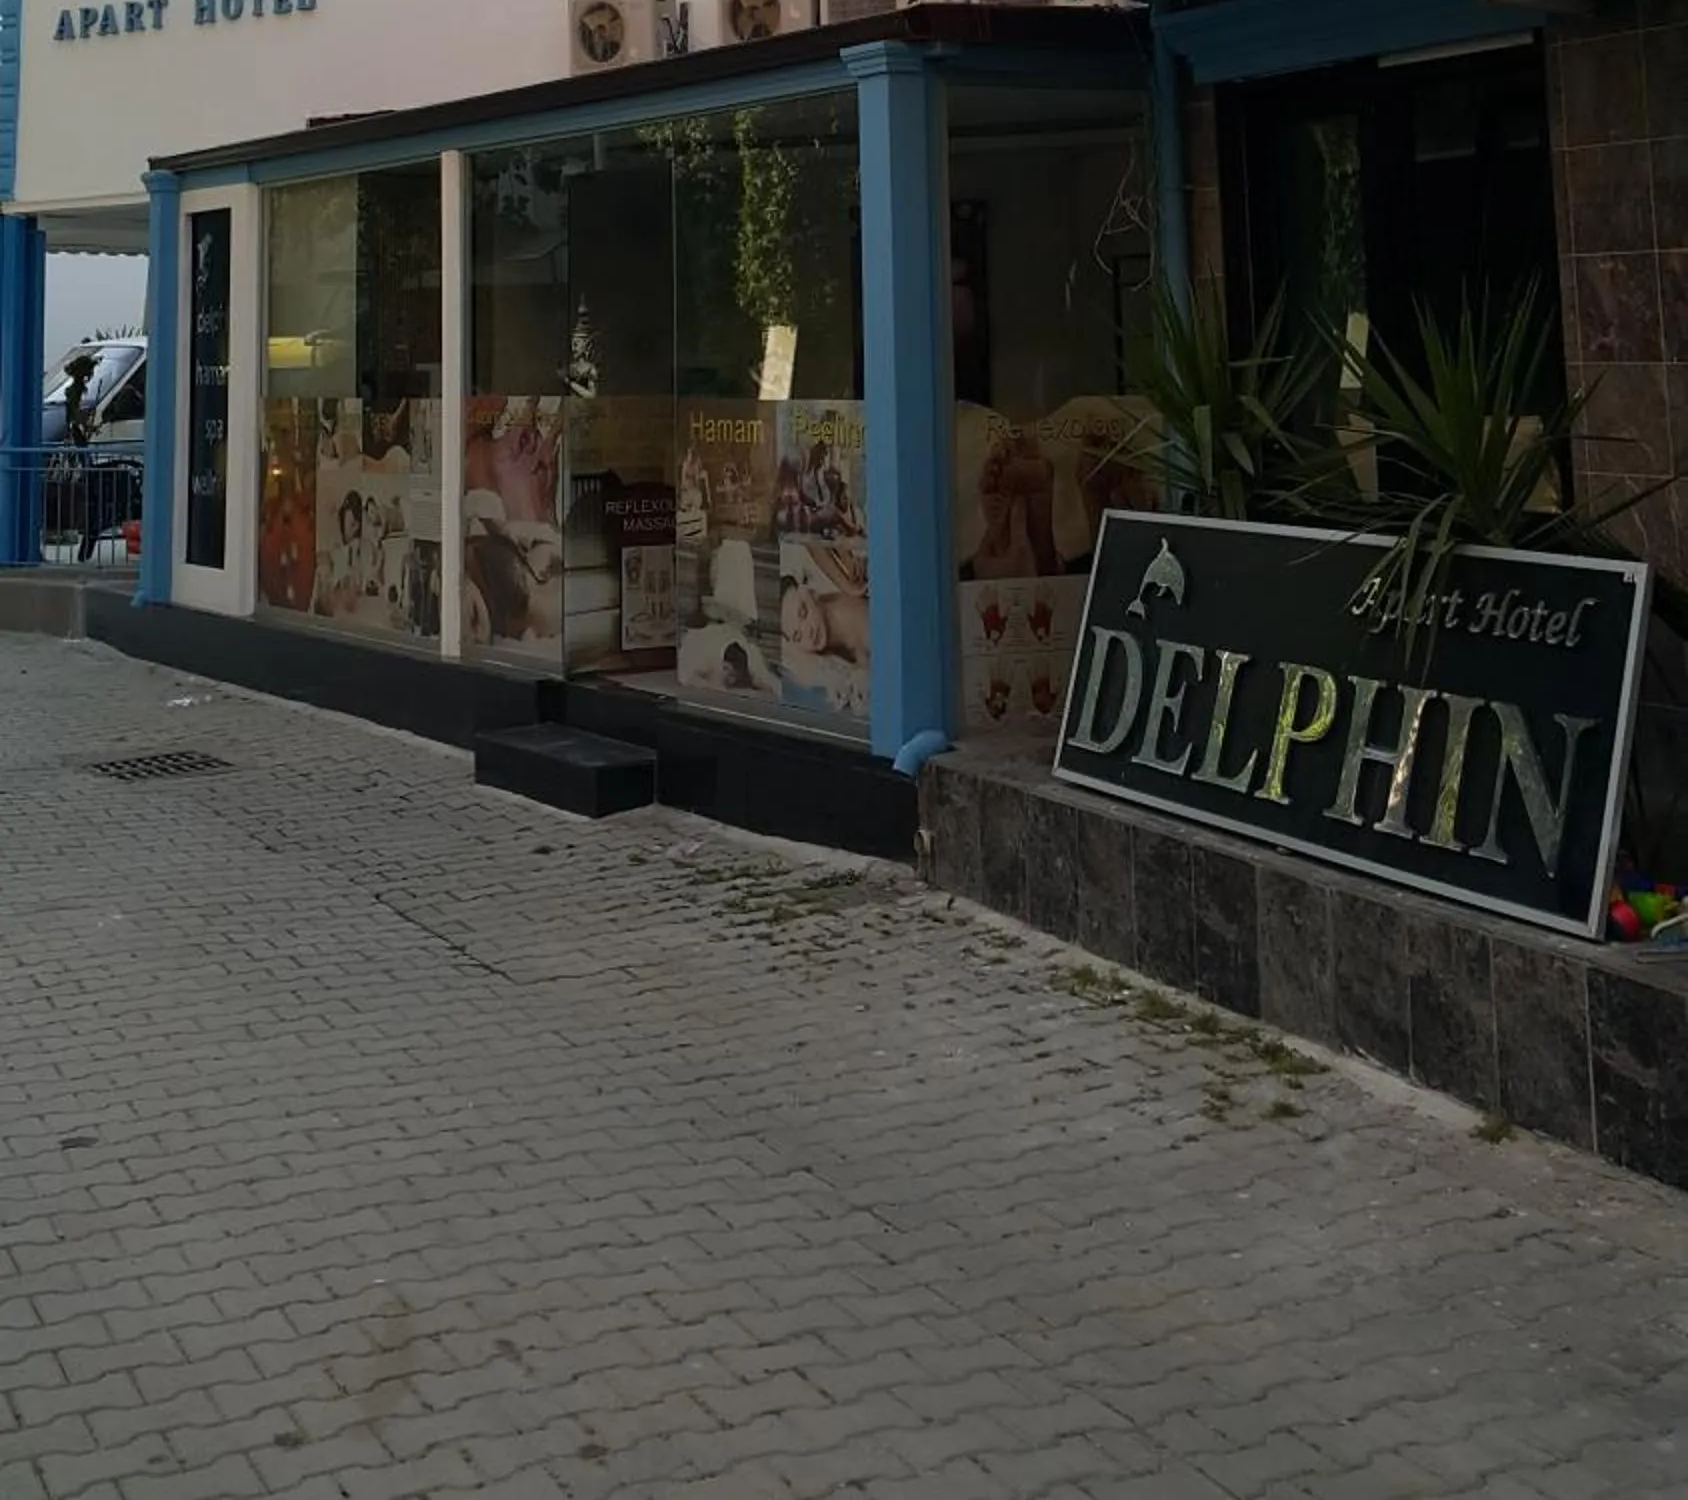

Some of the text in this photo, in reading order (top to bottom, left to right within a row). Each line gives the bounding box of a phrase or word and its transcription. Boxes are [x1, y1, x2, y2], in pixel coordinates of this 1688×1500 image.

[690, 411, 764, 445] Hamam
[1468, 588, 1600, 649] Hotel
[1067, 624, 1602, 879] DELPHIN
